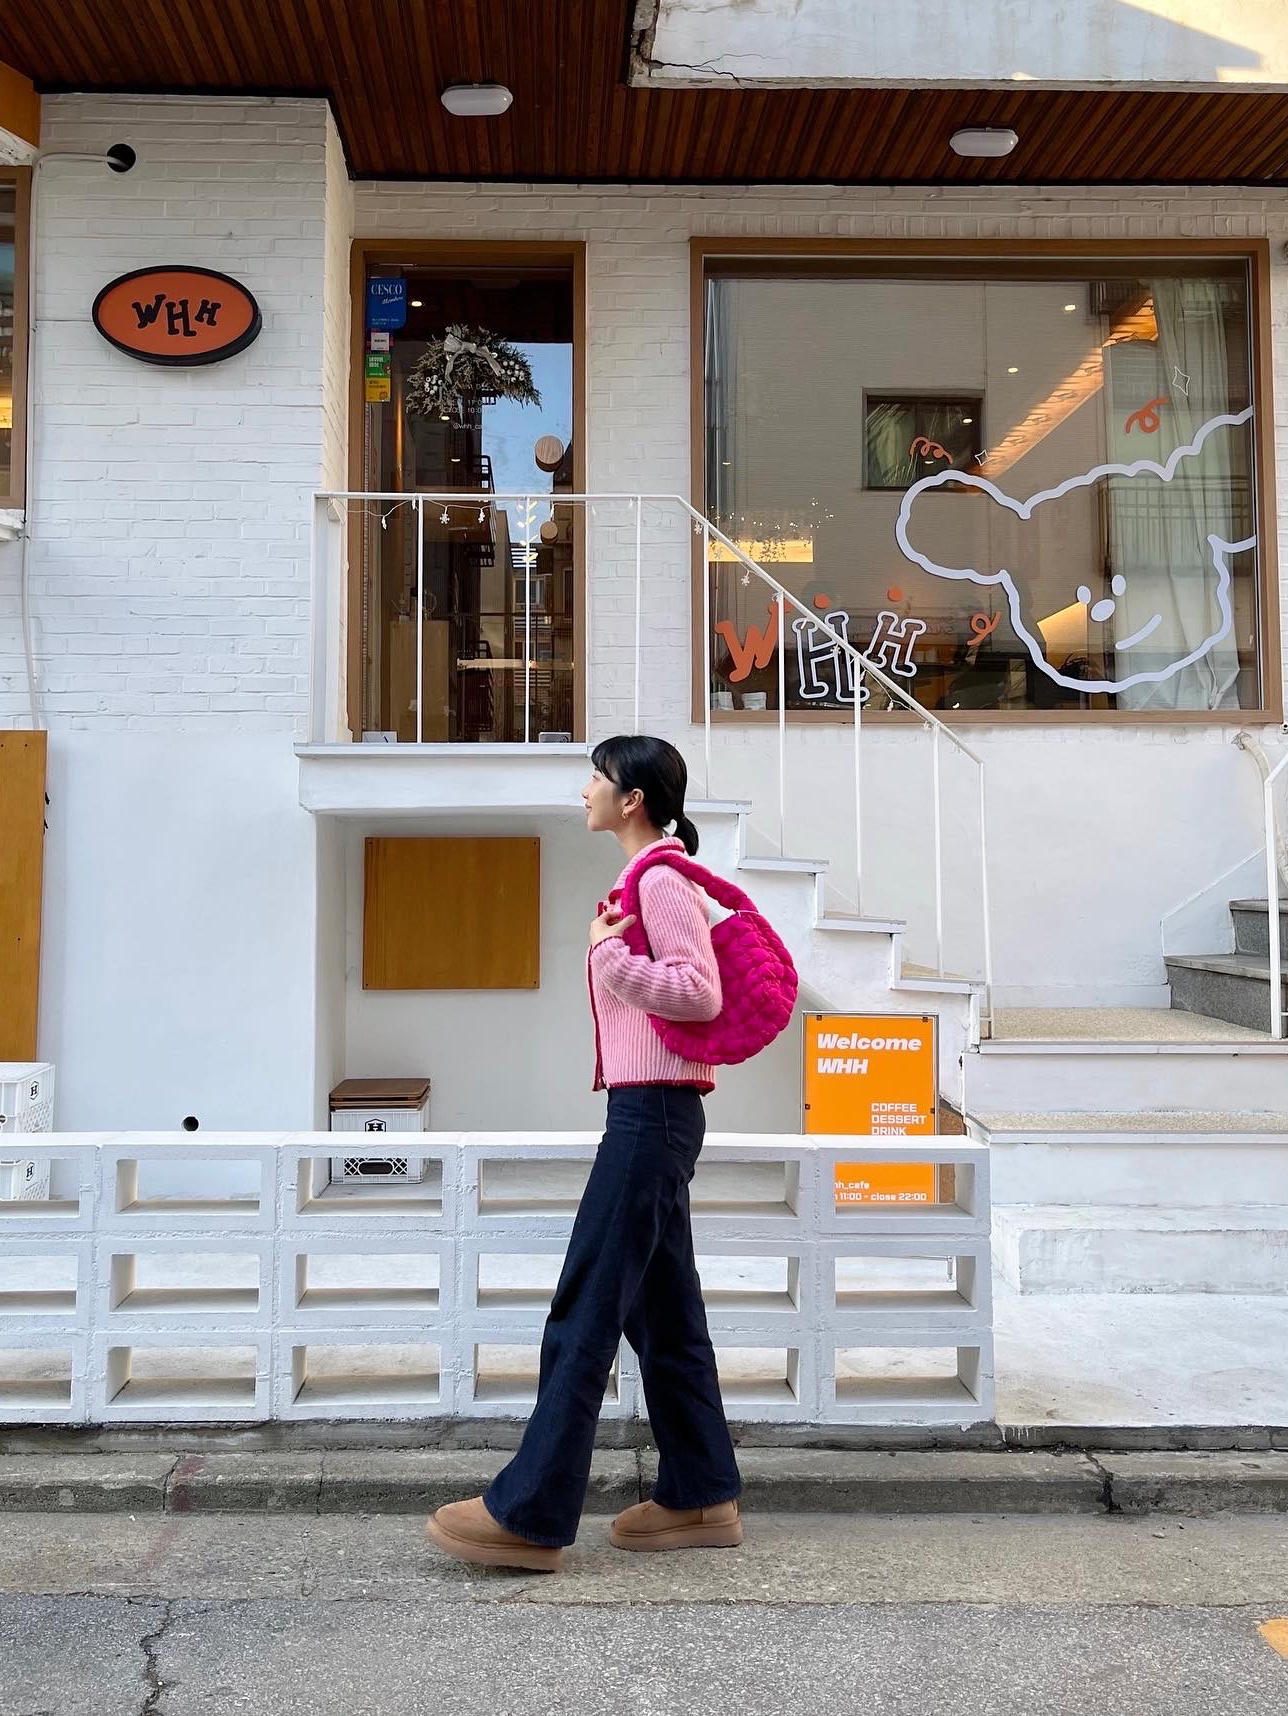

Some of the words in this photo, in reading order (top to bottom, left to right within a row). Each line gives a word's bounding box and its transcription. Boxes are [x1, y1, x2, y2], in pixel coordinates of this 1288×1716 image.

[371, 284, 403, 296] CESCO
[132, 294, 222, 337] WHH
[714, 600, 927, 702] WHH
[817, 1032, 922, 1051] Welcome
[817, 1058, 869, 1075] WHH
[871, 1103, 917, 1112] COFFEE
[871, 1114, 927, 1125] DESSERT
[871, 1126, 907, 1136] DRINK
[840, 1192, 862, 1201] 11:00
[870, 1192, 896, 1201] close
[898, 1192, 927, 1201] 22:00
